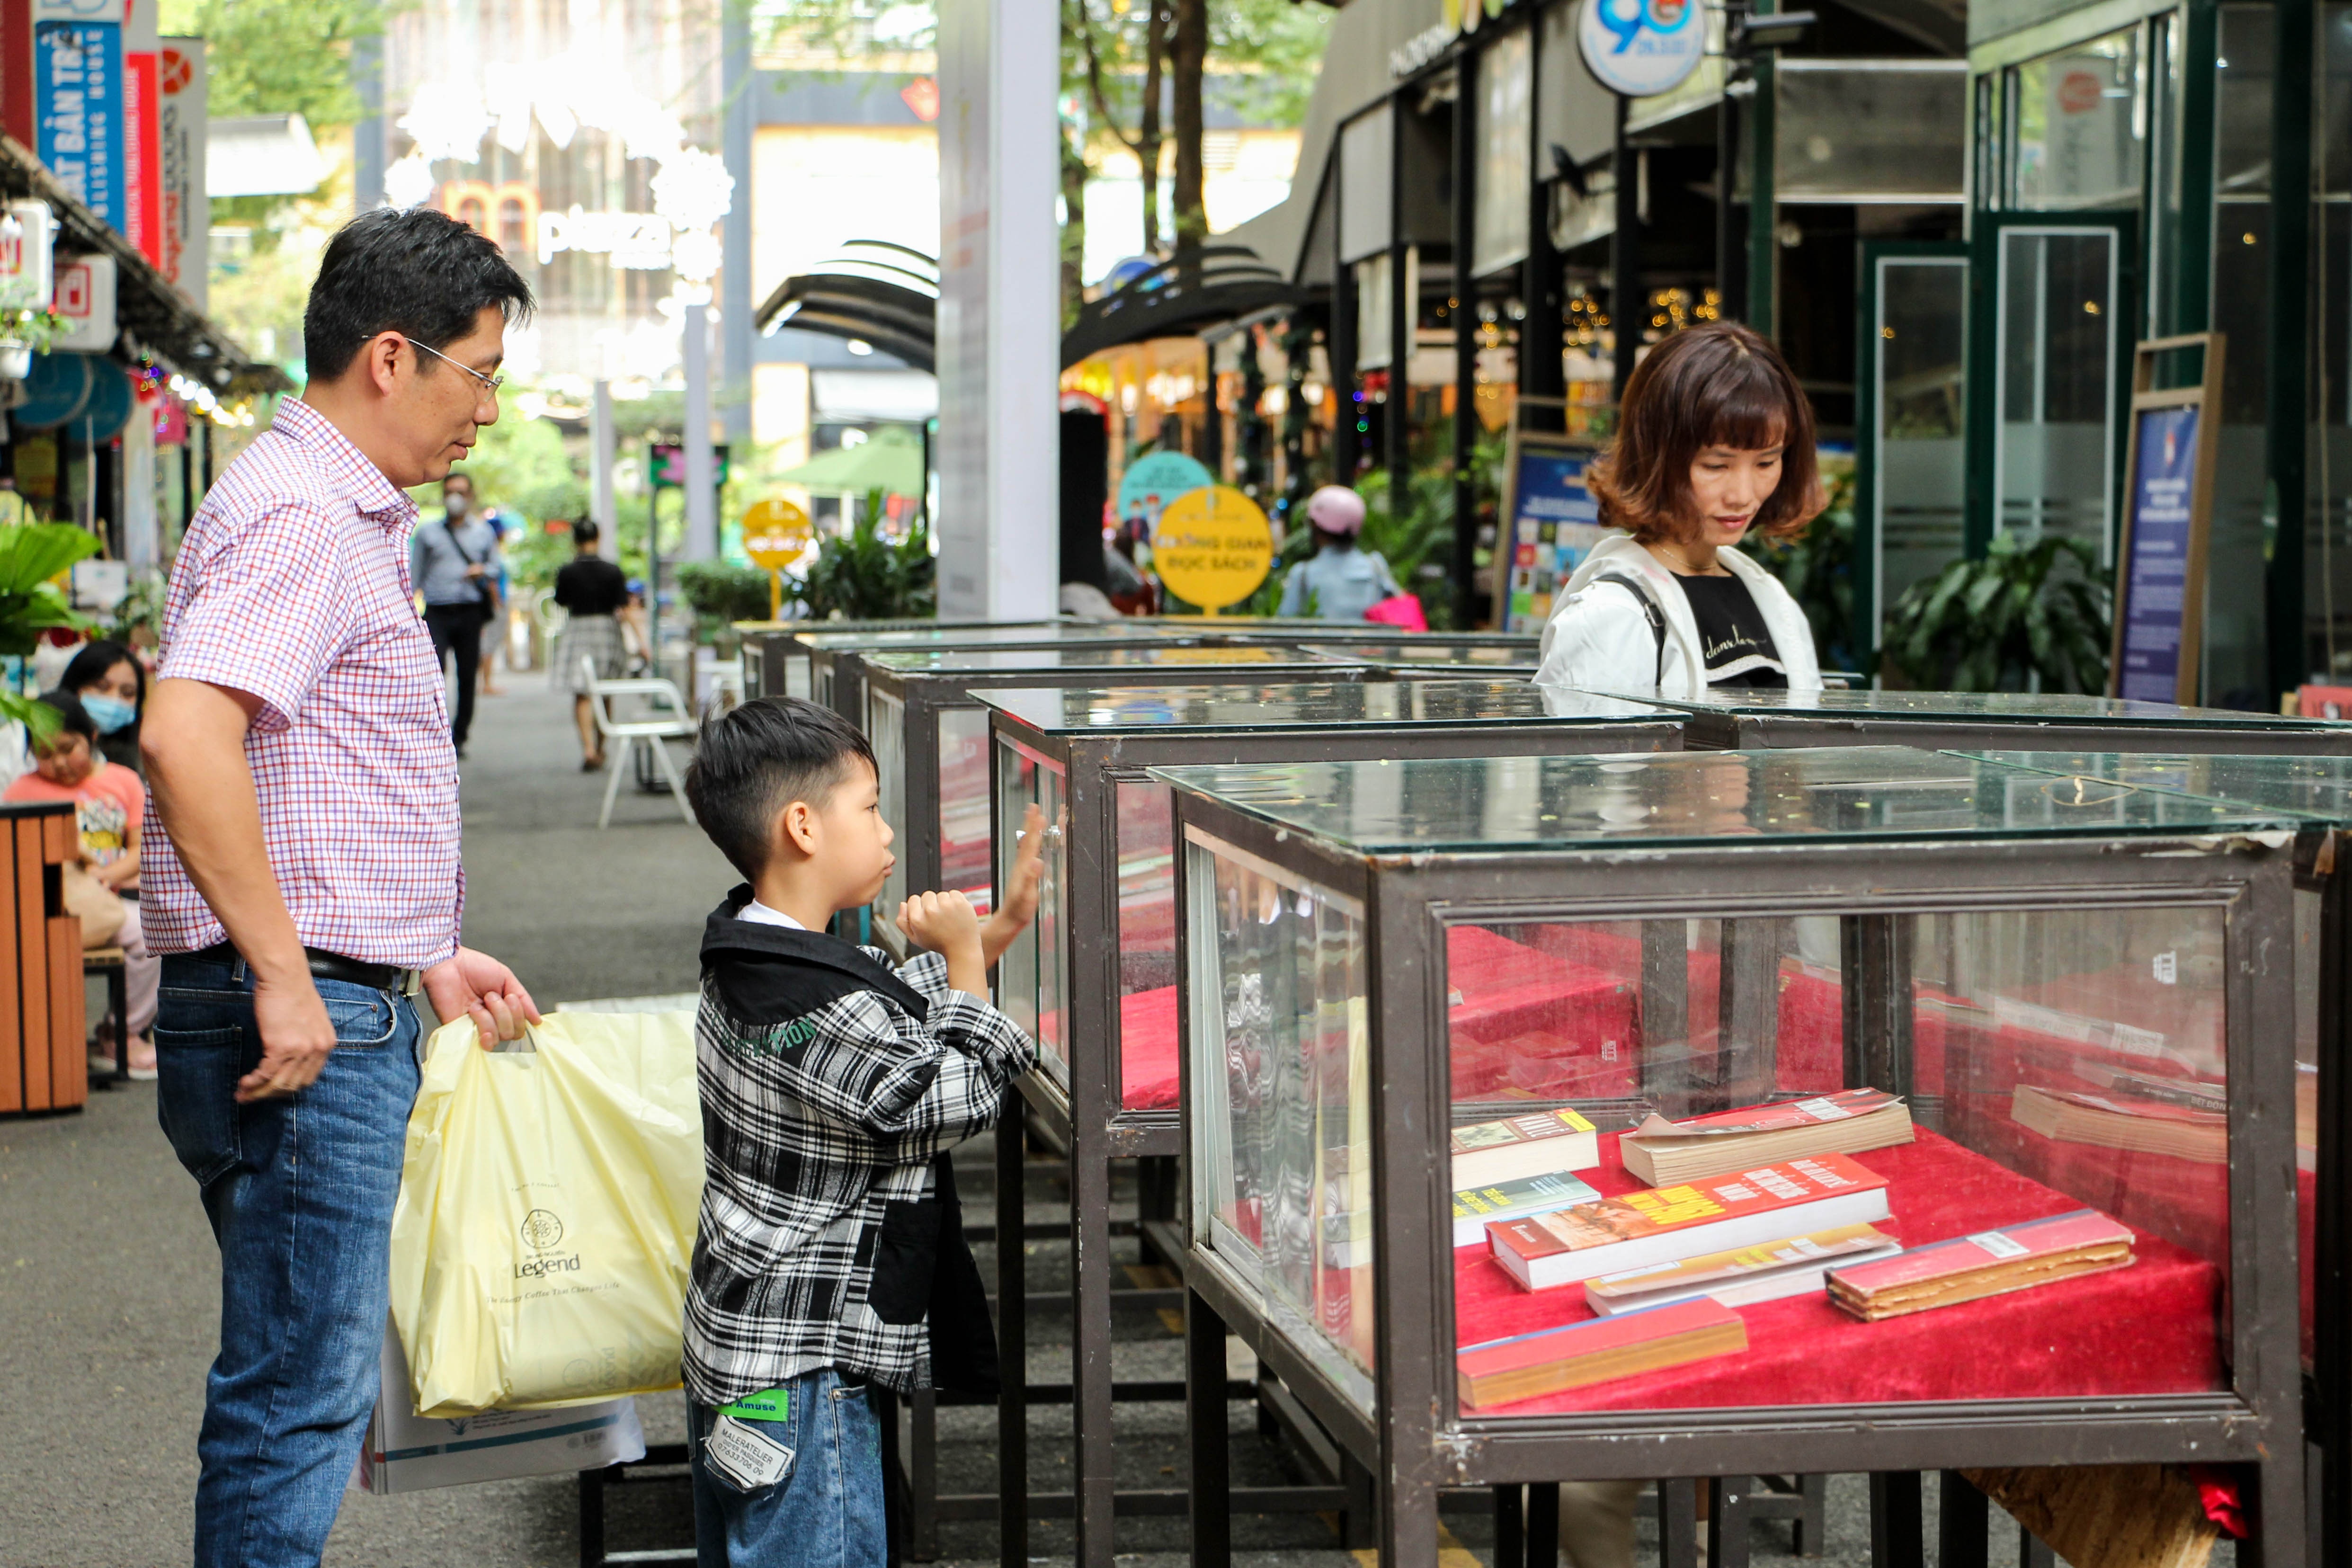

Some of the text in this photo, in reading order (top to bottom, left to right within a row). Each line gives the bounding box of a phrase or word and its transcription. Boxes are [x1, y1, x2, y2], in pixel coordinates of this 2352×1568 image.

[514, 1253, 580, 1279] Legend
[525, 1291, 550, 1299] Coffee
[736, 1400, 776, 1411] Amuse
[722, 1428, 773, 1465] MALERATELIER
[753, 1467, 764, 1476] 09
